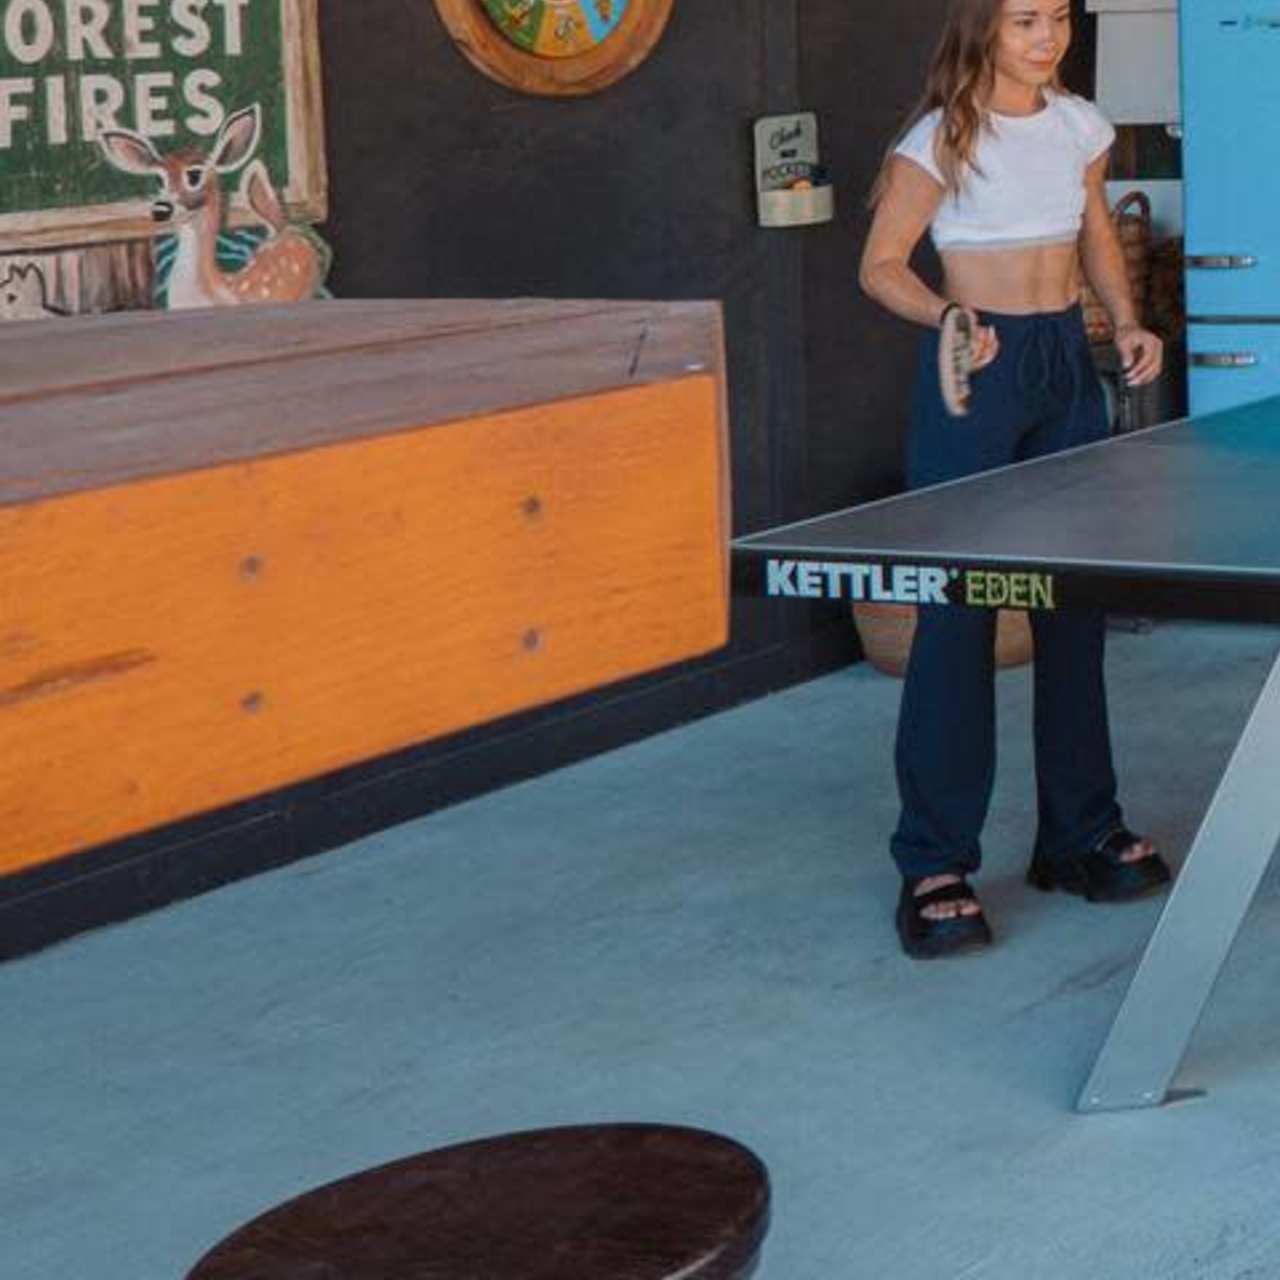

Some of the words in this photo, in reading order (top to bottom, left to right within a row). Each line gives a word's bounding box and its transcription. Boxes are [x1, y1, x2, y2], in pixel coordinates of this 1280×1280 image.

[0, 68, 224, 148] FIRES
[767, 558, 950, 604] KETTLER
[965, 570, 1055, 609] EDEN
